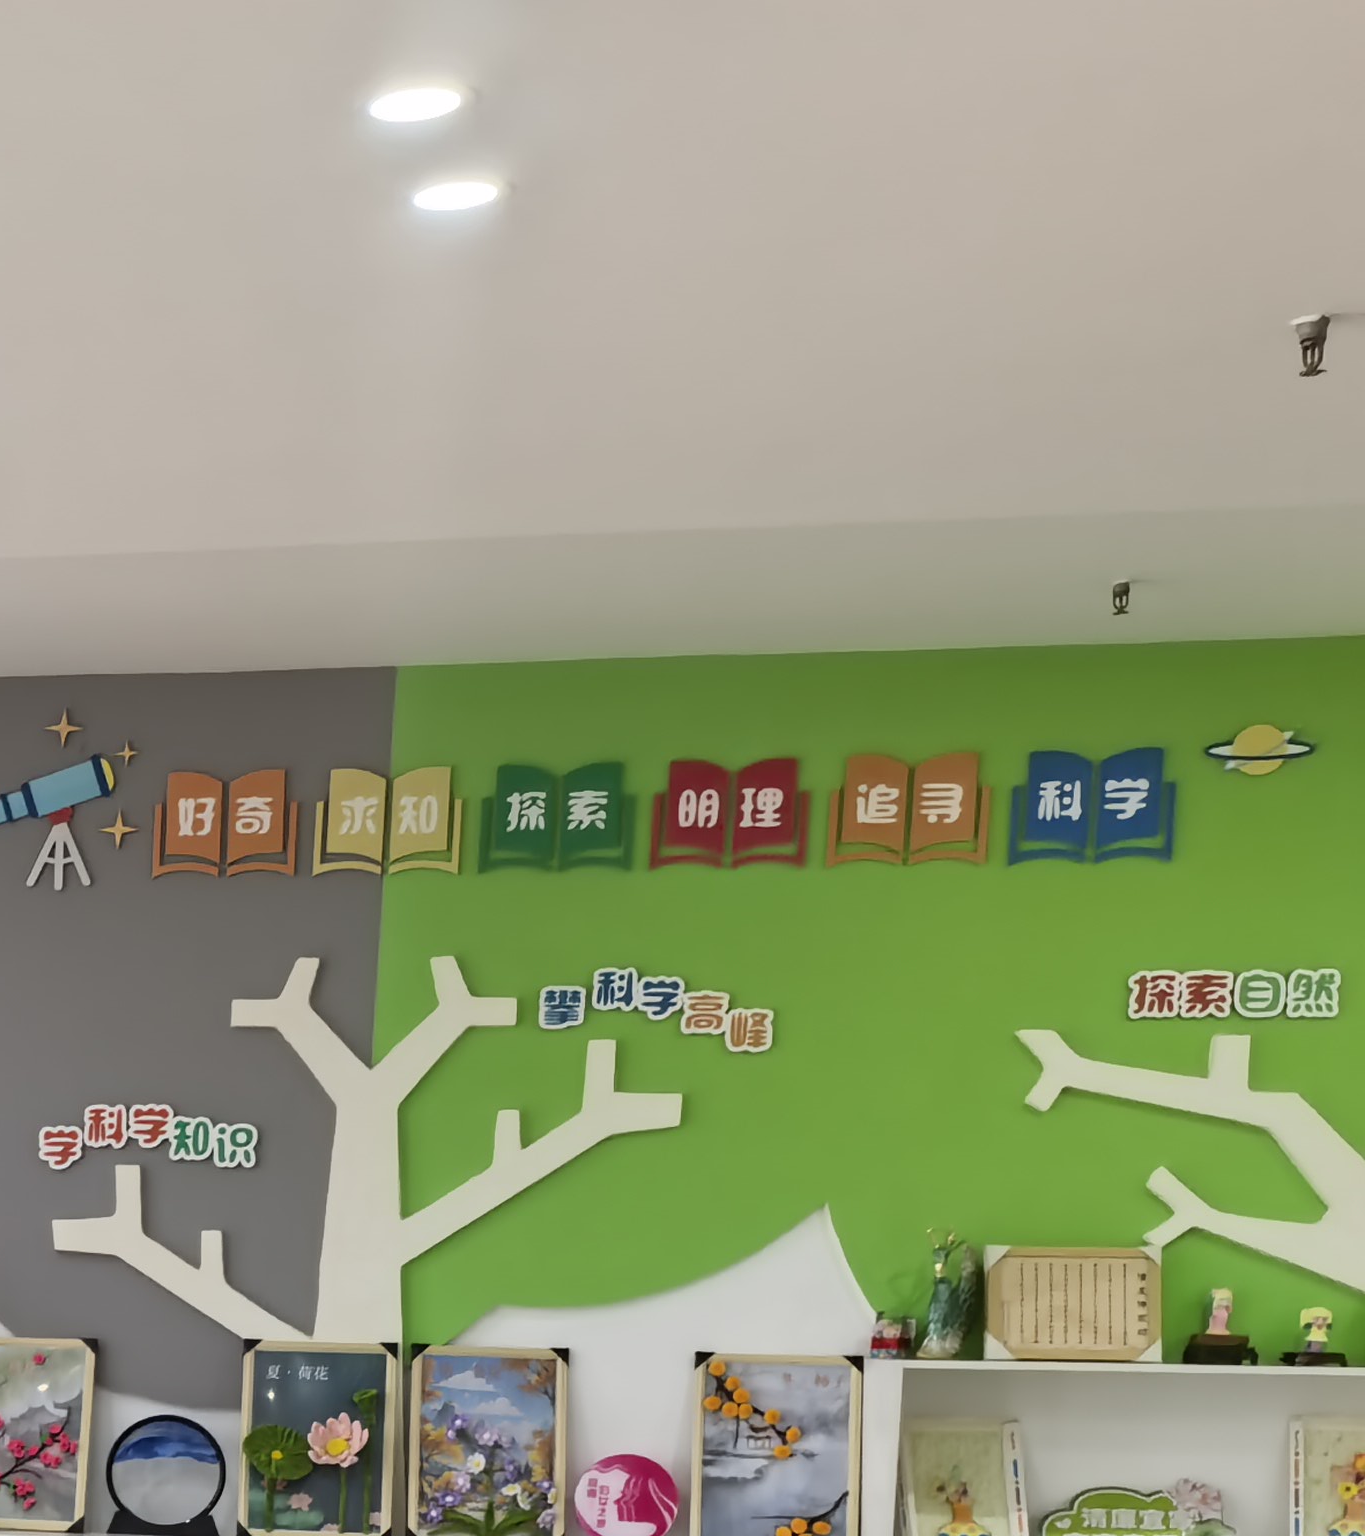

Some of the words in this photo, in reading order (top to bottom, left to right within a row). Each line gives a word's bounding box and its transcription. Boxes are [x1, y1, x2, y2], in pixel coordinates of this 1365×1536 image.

[177, 795, 274, 837] 好奇
[338, 793, 439, 837] 求知
[505, 790, 610, 833] 探索
[676, 786, 785, 829] 明理
[855, 781, 964, 825] 追寻
[1036, 777, 1150, 821] 科学
[541, 969, 772, 1050] 攀科学高峰
[1129, 970, 1340, 1018] 探索自然
[41, 1105, 256, 1168] 学科学知识
